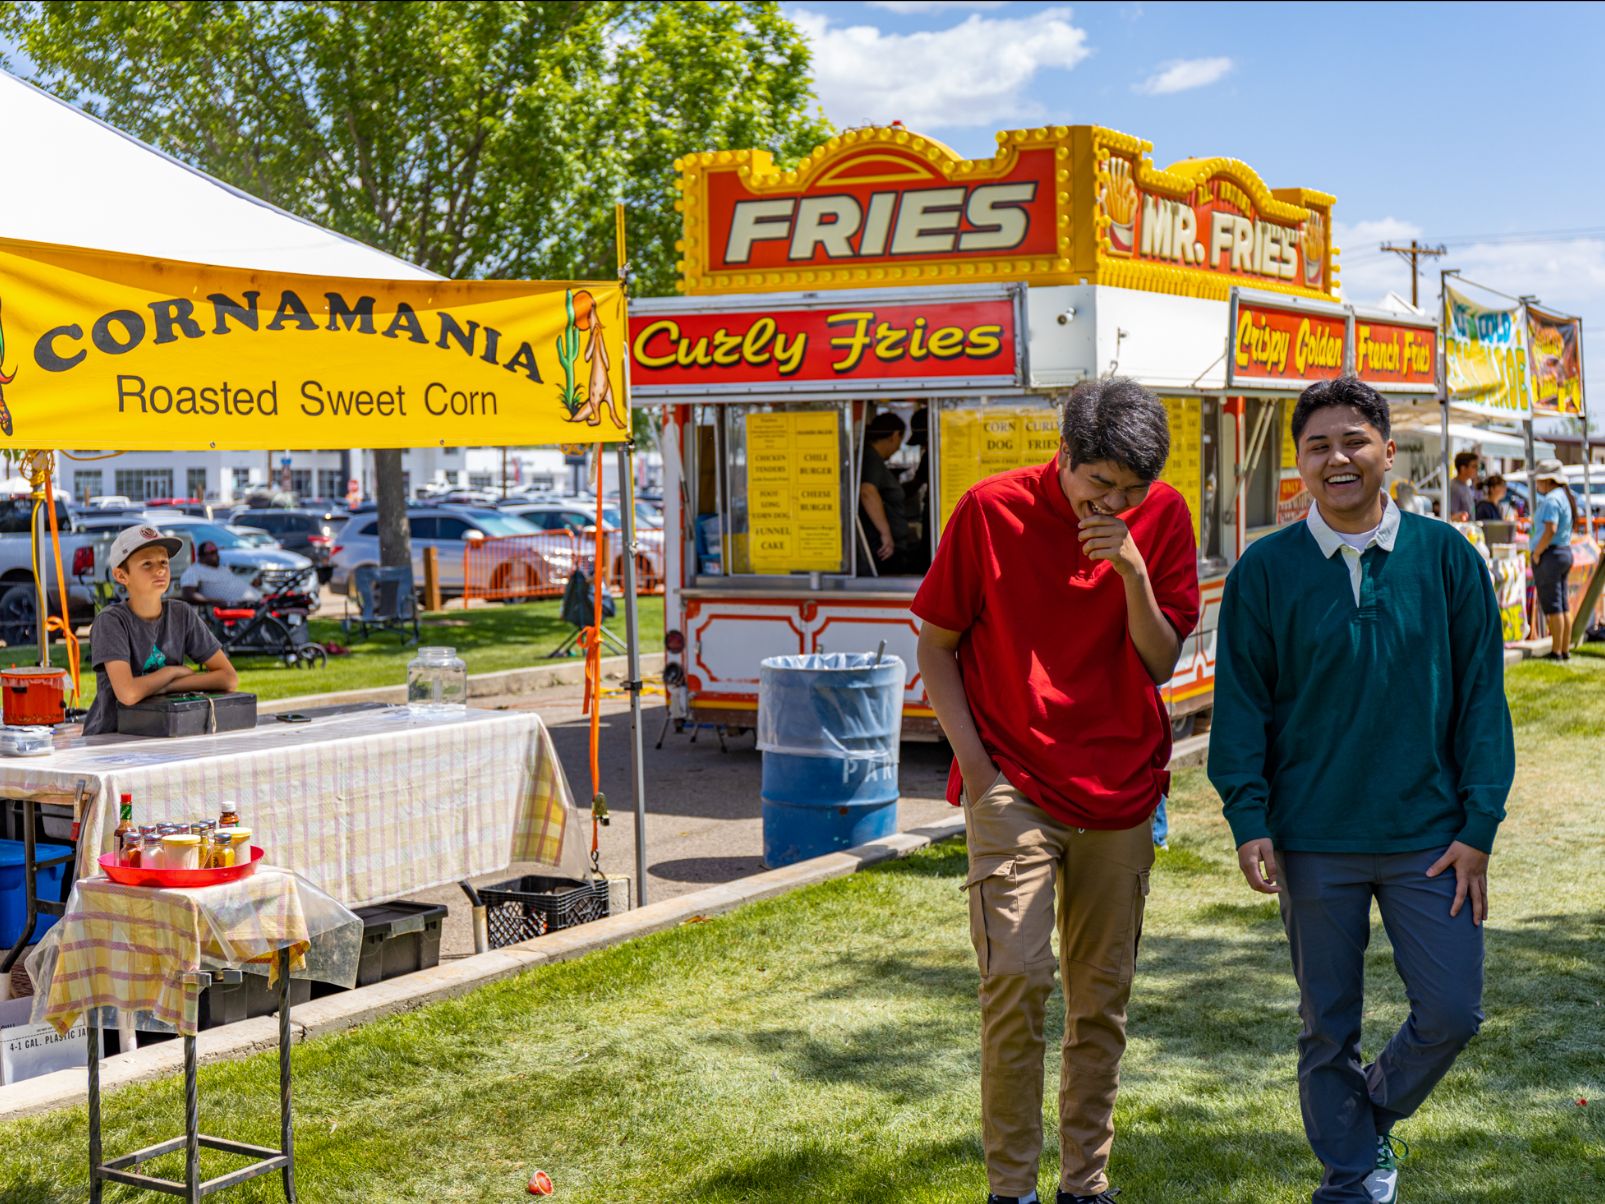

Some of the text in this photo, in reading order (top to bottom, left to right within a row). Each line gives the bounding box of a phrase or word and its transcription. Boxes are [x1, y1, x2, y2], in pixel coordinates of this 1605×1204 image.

[723, 180, 1038, 264] FRIES
[1140, 193, 1205, 265] MR.
[1210, 211, 1298, 281] FRIES
[34, 290, 544, 384] CORNAMANIA
[633, 310, 1003, 377] Curly Fries
[1236, 311, 1343, 375] Crispy Golden
[1356, 325, 1400, 374] French
[1402, 331, 1430, 376] Fries
[117, 374, 498, 416] Roasted Sweet Corn
[983, 422, 1016, 432] CORN
[987, 439, 1059, 450] DOG FRIES
[755, 454, 787, 462] CHICKEN
[803, 453, 828, 462] CHILE
[755, 465, 786, 473] TENDERS
[800, 467, 833, 475] BURGER
[801, 490, 831, 499] CHEESE
[800, 503, 833, 511] BURGER
[774, 512, 790, 520] DOG
[755, 527, 791, 536] FUNNEL
[761, 541, 785, 550] CAKE
[9, 1042, 22, 1052] 4-1
[25, 1038, 42, 1048] GAL.
